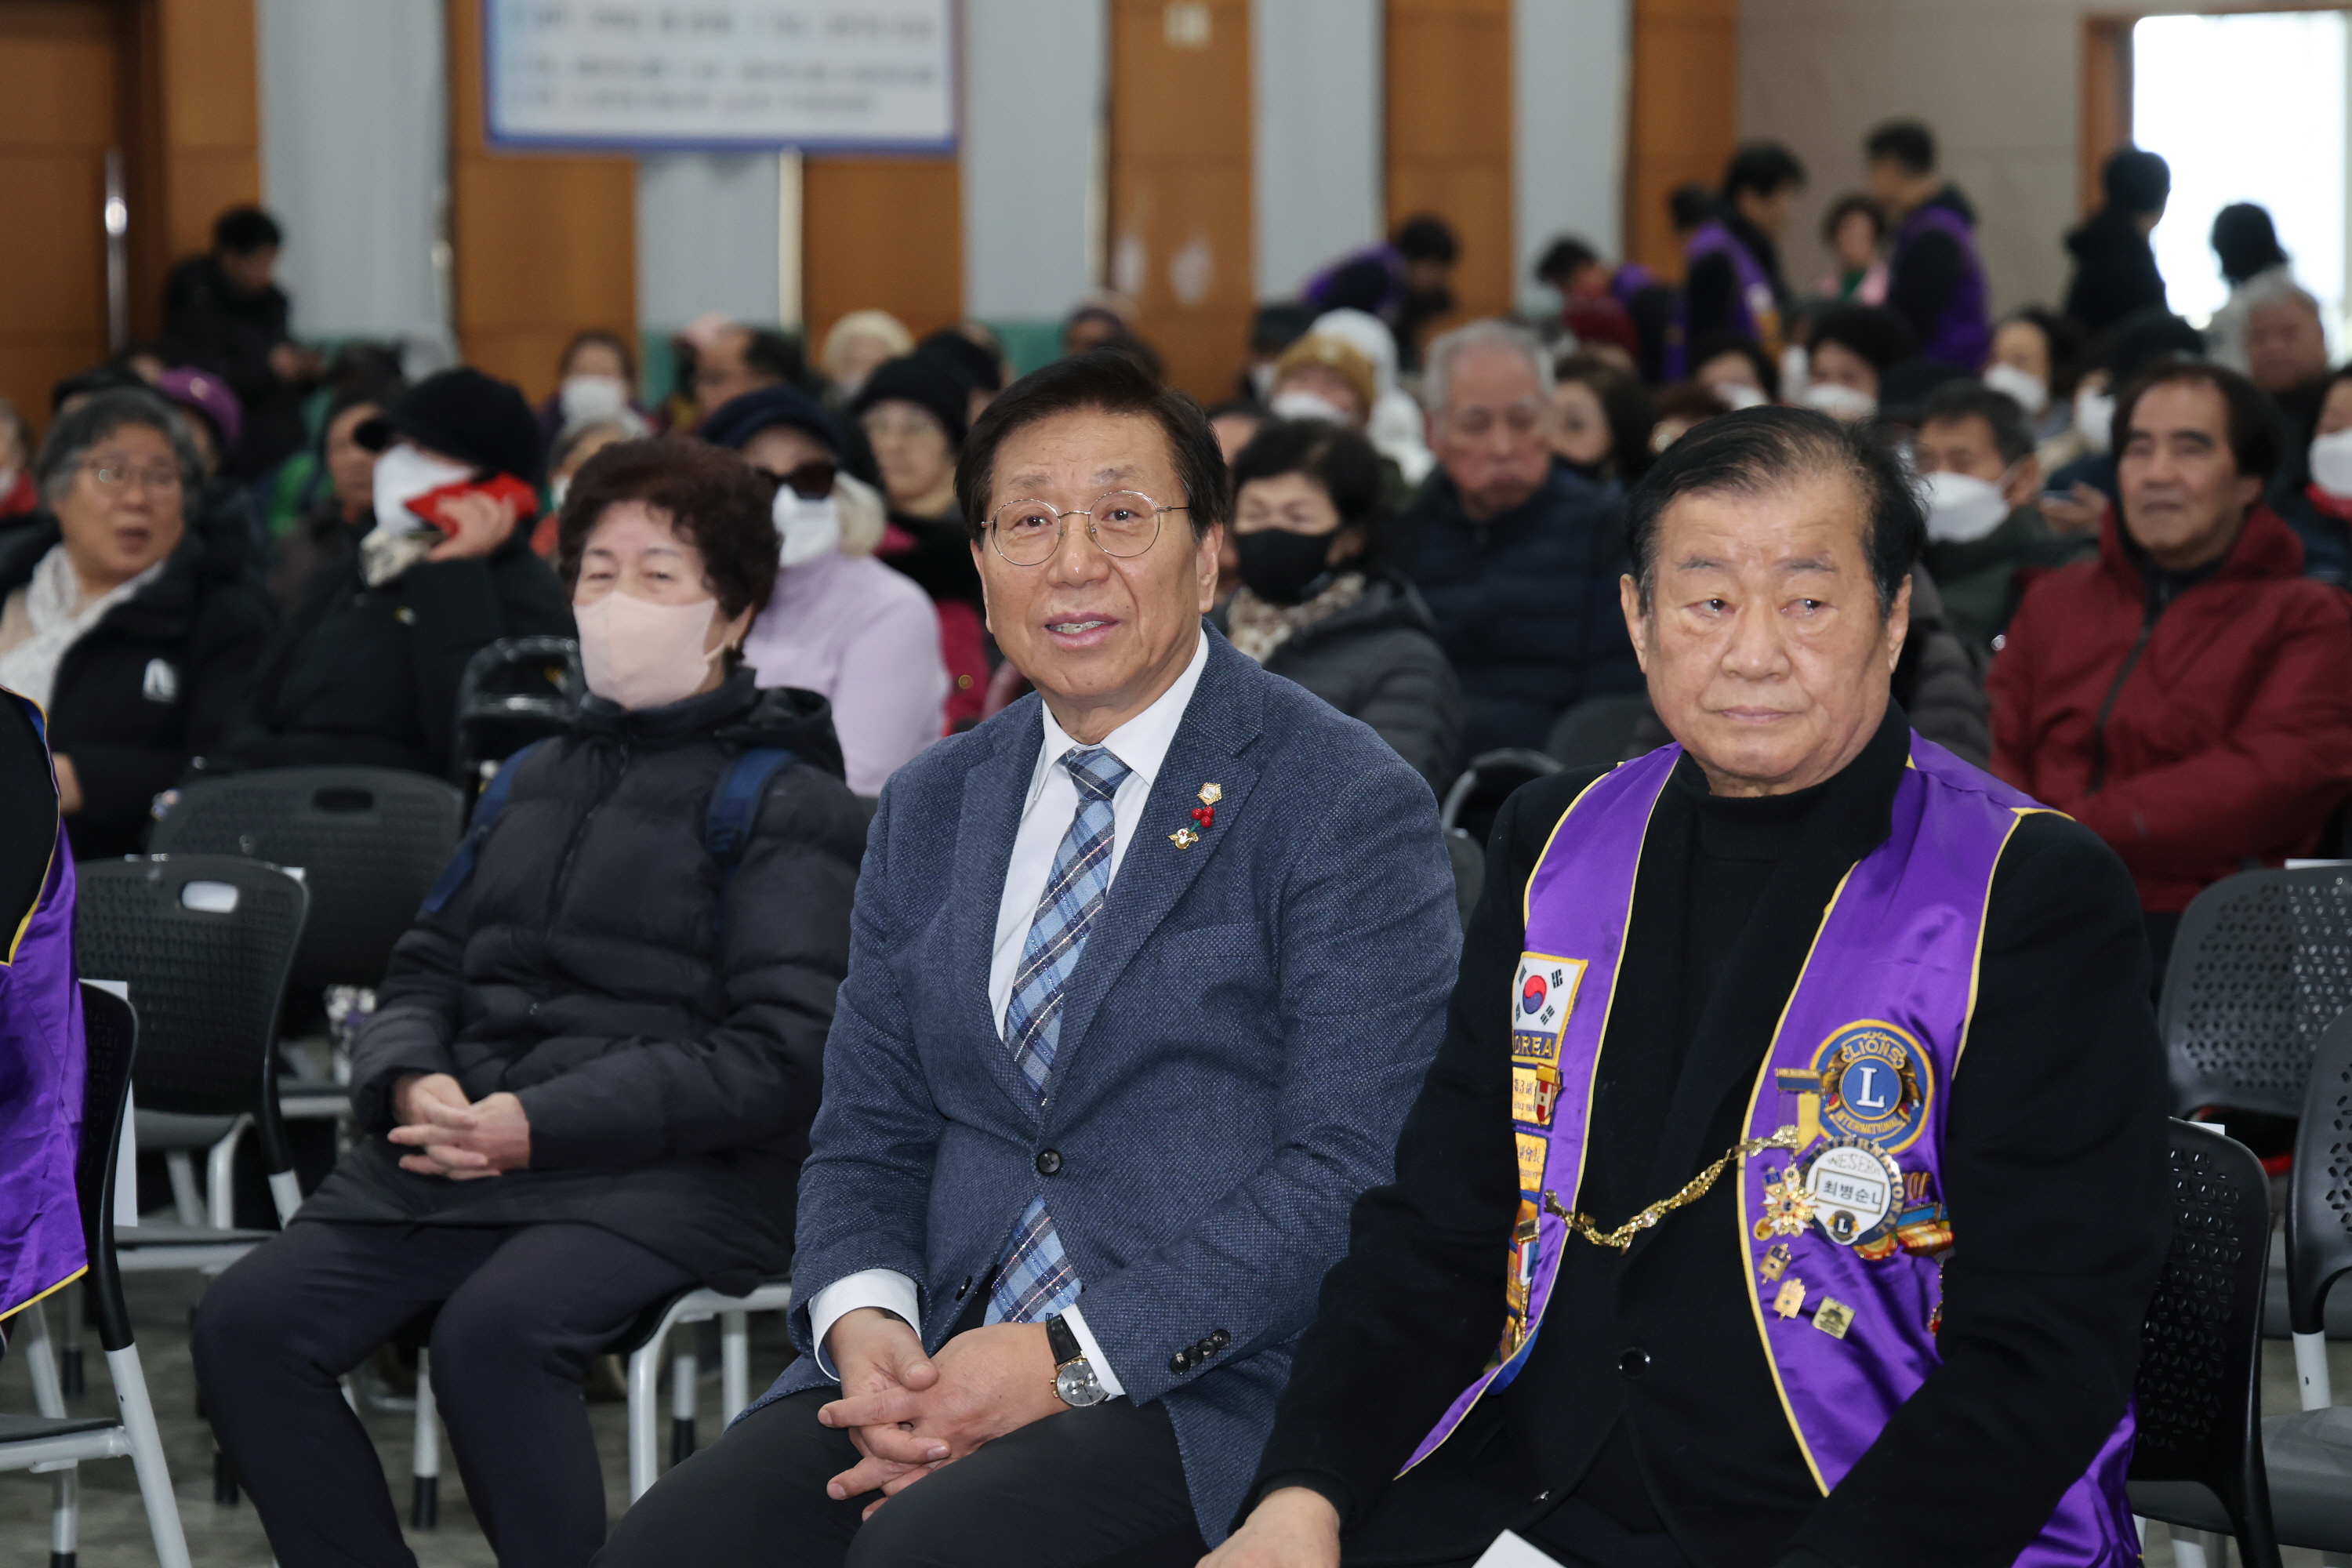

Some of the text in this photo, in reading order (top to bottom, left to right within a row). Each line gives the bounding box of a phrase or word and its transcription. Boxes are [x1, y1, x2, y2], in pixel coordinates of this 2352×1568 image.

[1514, 1035, 1552, 1057] OREA
[1848, 1039, 1902, 1063] LIONS
[1856, 1066, 1885, 1109] L
[1837, 1217, 1849, 1233] L
